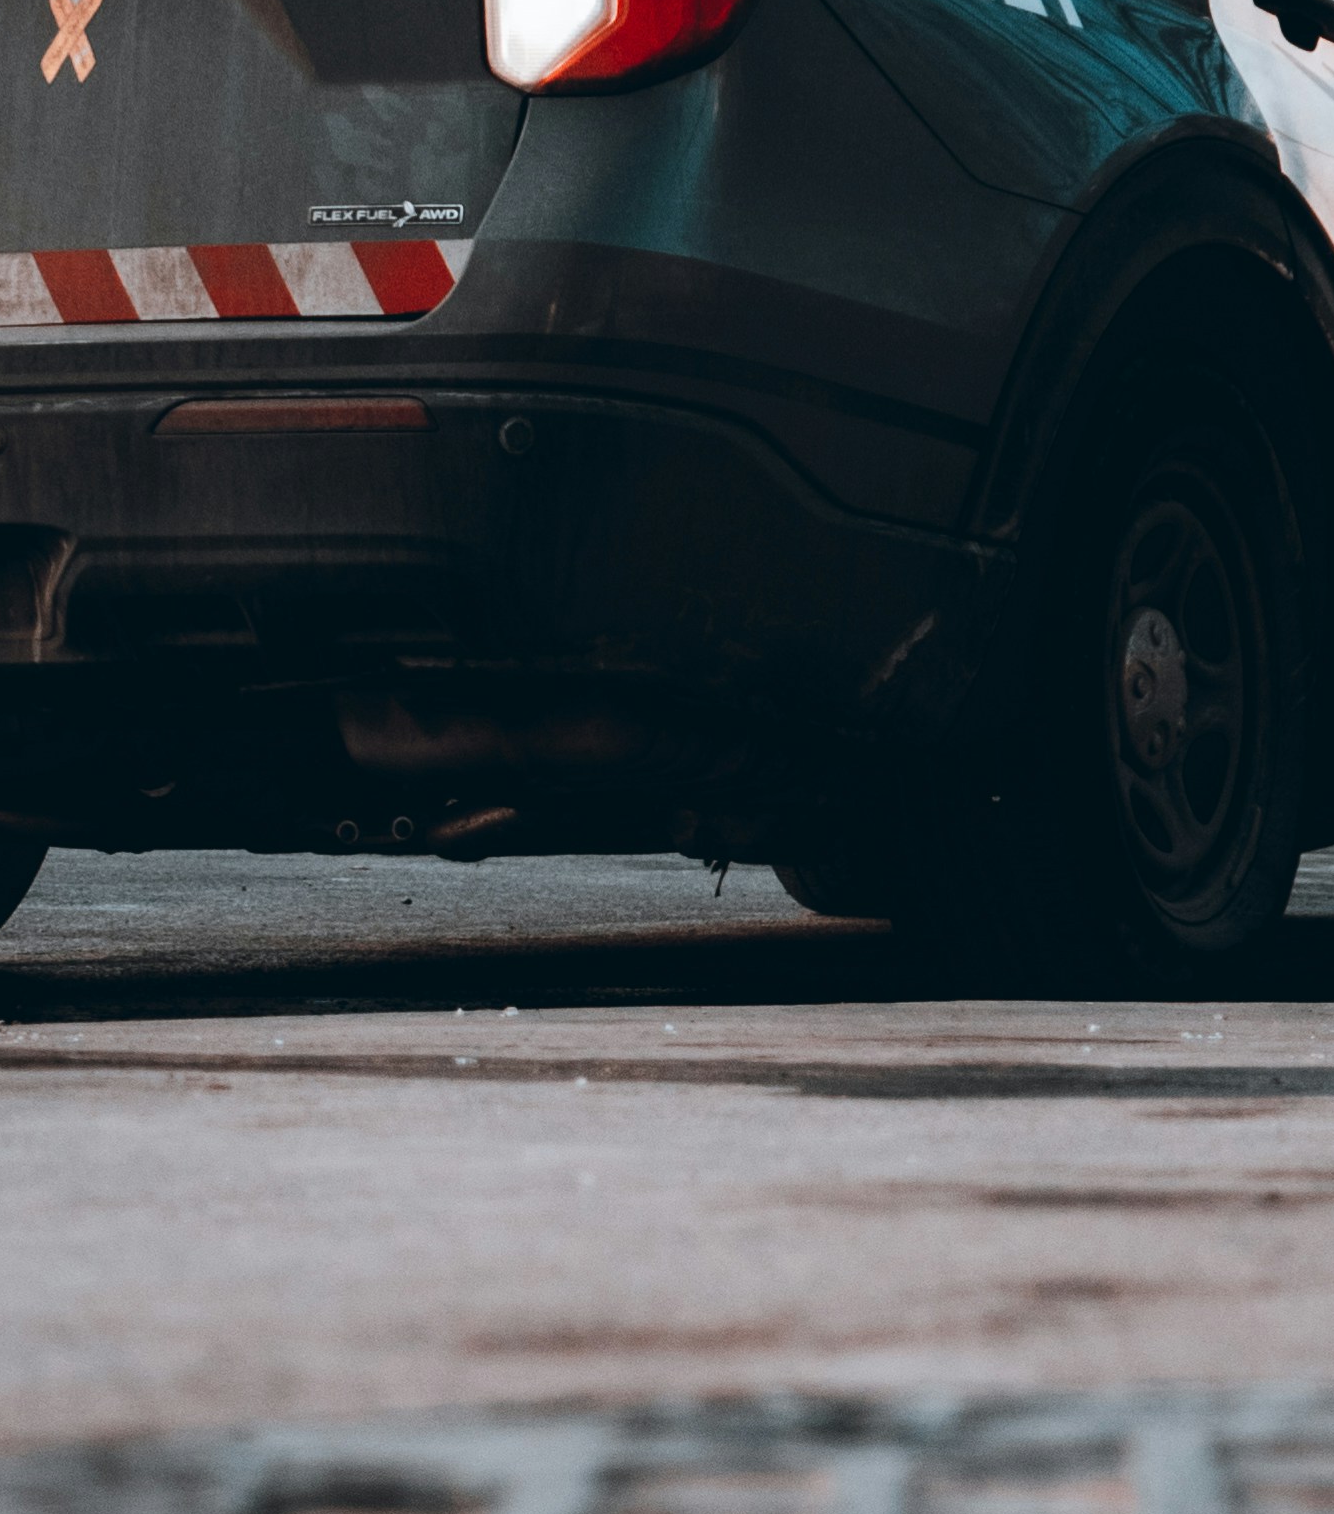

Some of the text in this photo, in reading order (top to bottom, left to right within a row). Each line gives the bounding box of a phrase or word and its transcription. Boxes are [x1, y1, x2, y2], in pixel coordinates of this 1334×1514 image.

[312, 208, 459, 222] FLEX FUEL AWD
